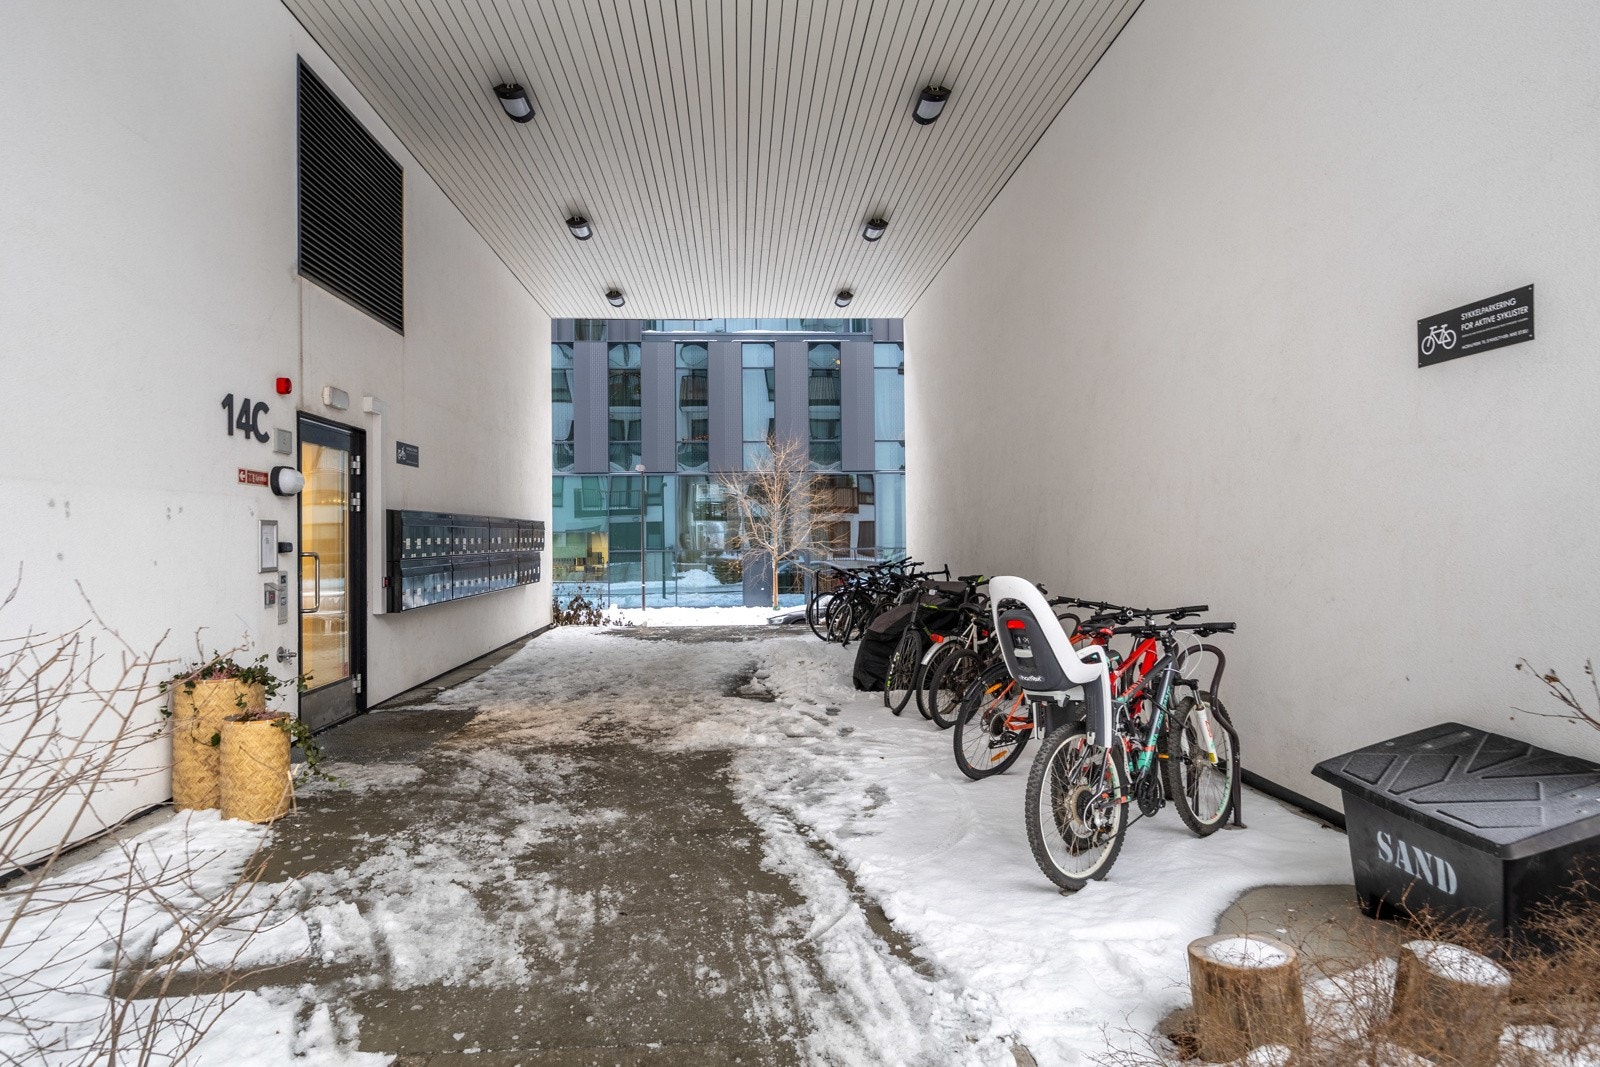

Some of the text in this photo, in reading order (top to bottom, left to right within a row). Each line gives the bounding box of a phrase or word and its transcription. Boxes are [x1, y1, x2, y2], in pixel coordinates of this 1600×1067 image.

[1461, 297, 1516, 320] SYKKELPARKERING
[1461, 321, 1474, 331] FOR
[1474, 315, 1496, 328] AKTIVE
[1496, 305, 1529, 321] SYKLISTER
[221, 393, 270, 443] 14C
[1377, 831, 1457, 895] SAND
